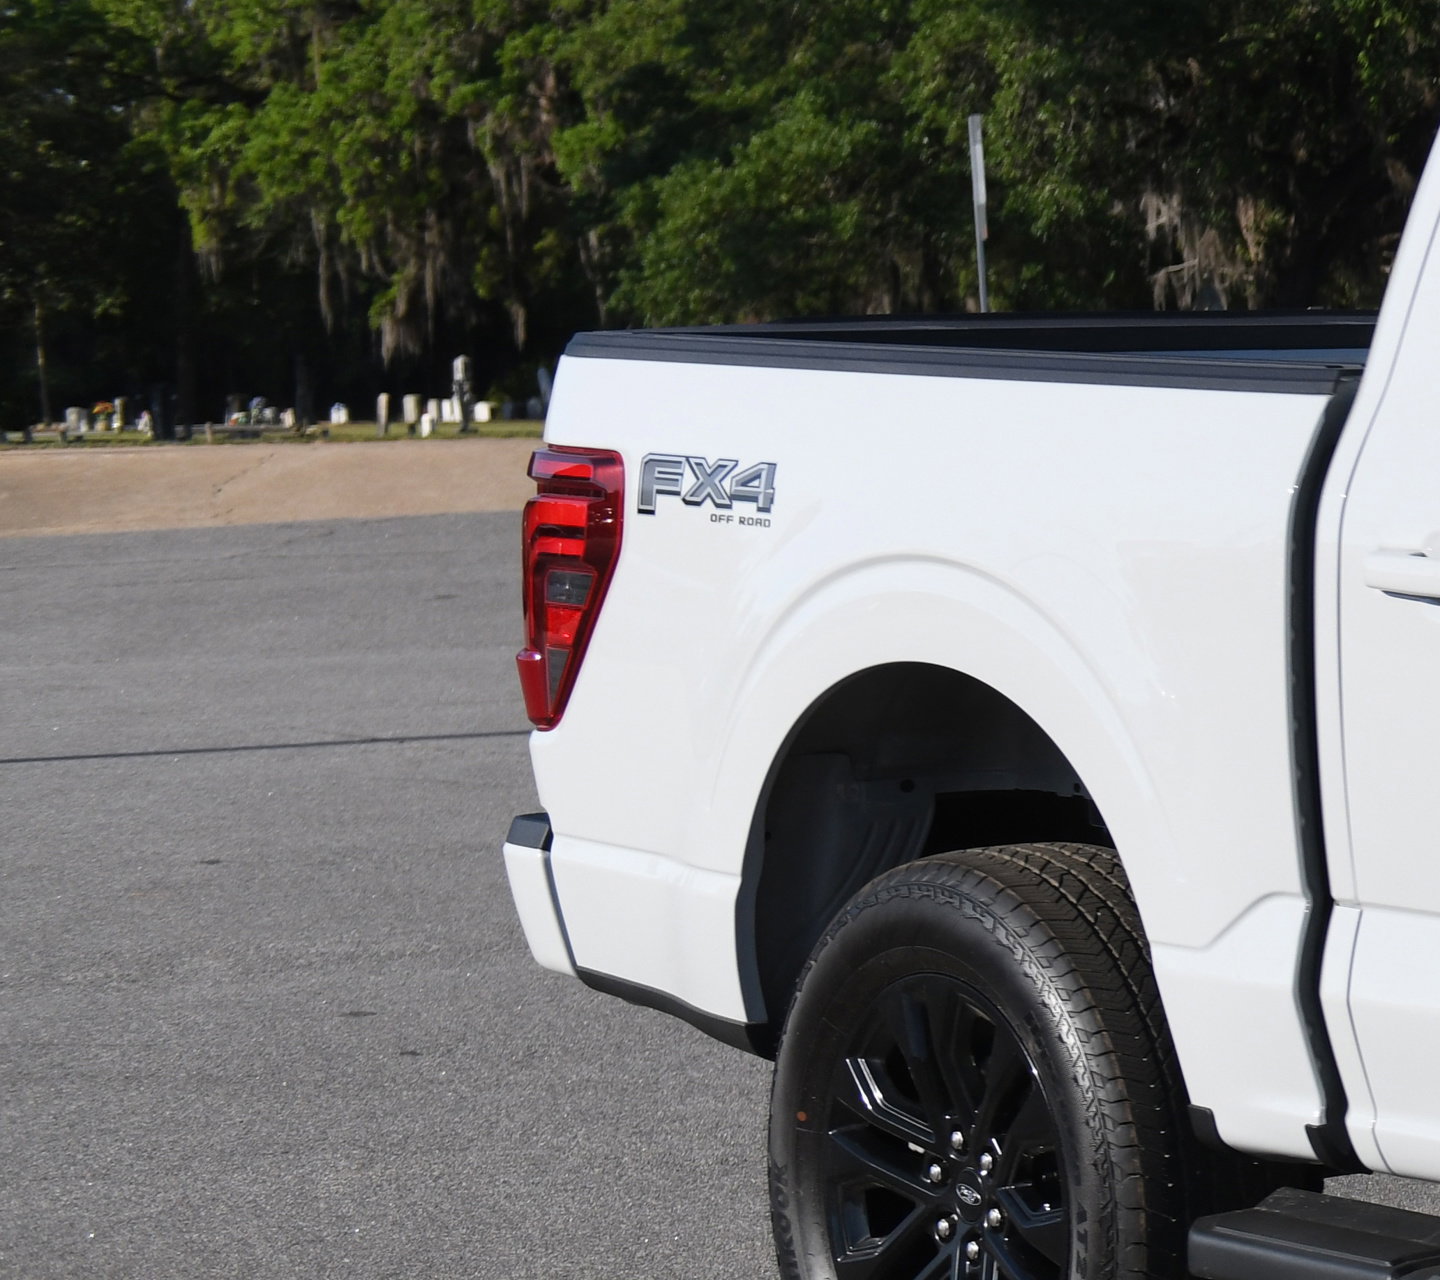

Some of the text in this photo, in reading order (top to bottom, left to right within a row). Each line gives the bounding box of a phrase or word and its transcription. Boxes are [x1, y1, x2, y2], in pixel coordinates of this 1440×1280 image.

[637, 453, 778, 515] FX4
[710, 513, 772, 528] OFF ROAD
